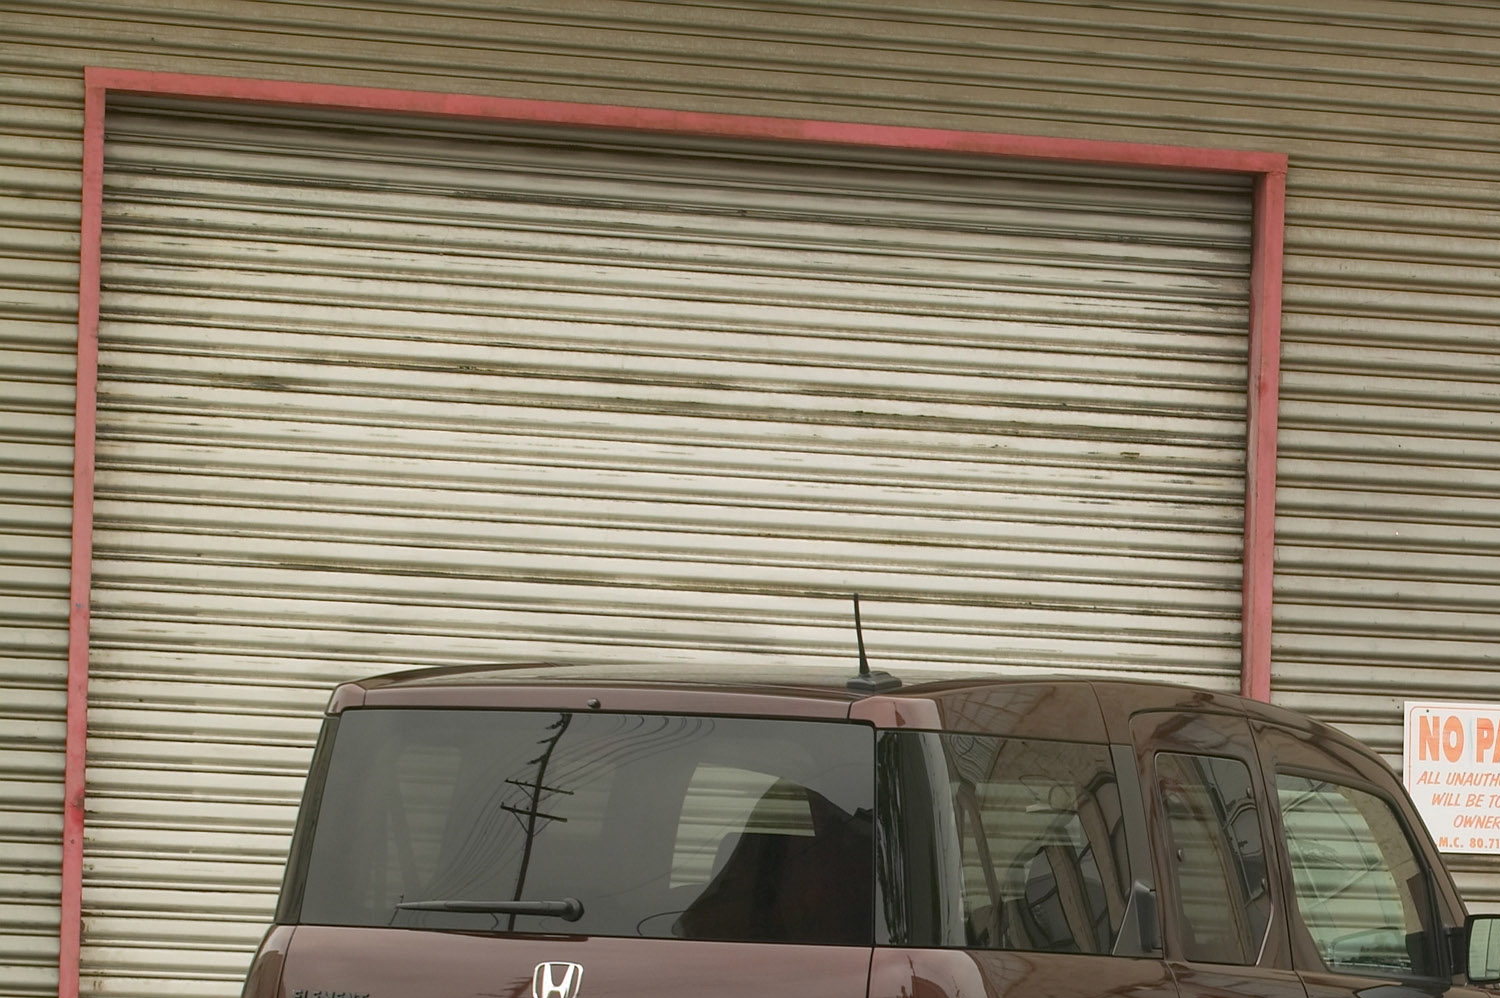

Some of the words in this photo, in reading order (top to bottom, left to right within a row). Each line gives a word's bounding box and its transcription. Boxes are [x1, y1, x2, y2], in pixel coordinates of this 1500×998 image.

[1418, 715, 1464, 763] NO
[1416, 771, 1441, 785] ALL
[1431, 793, 1461, 807] WILL
[1465, 794, 1485, 808] BE
